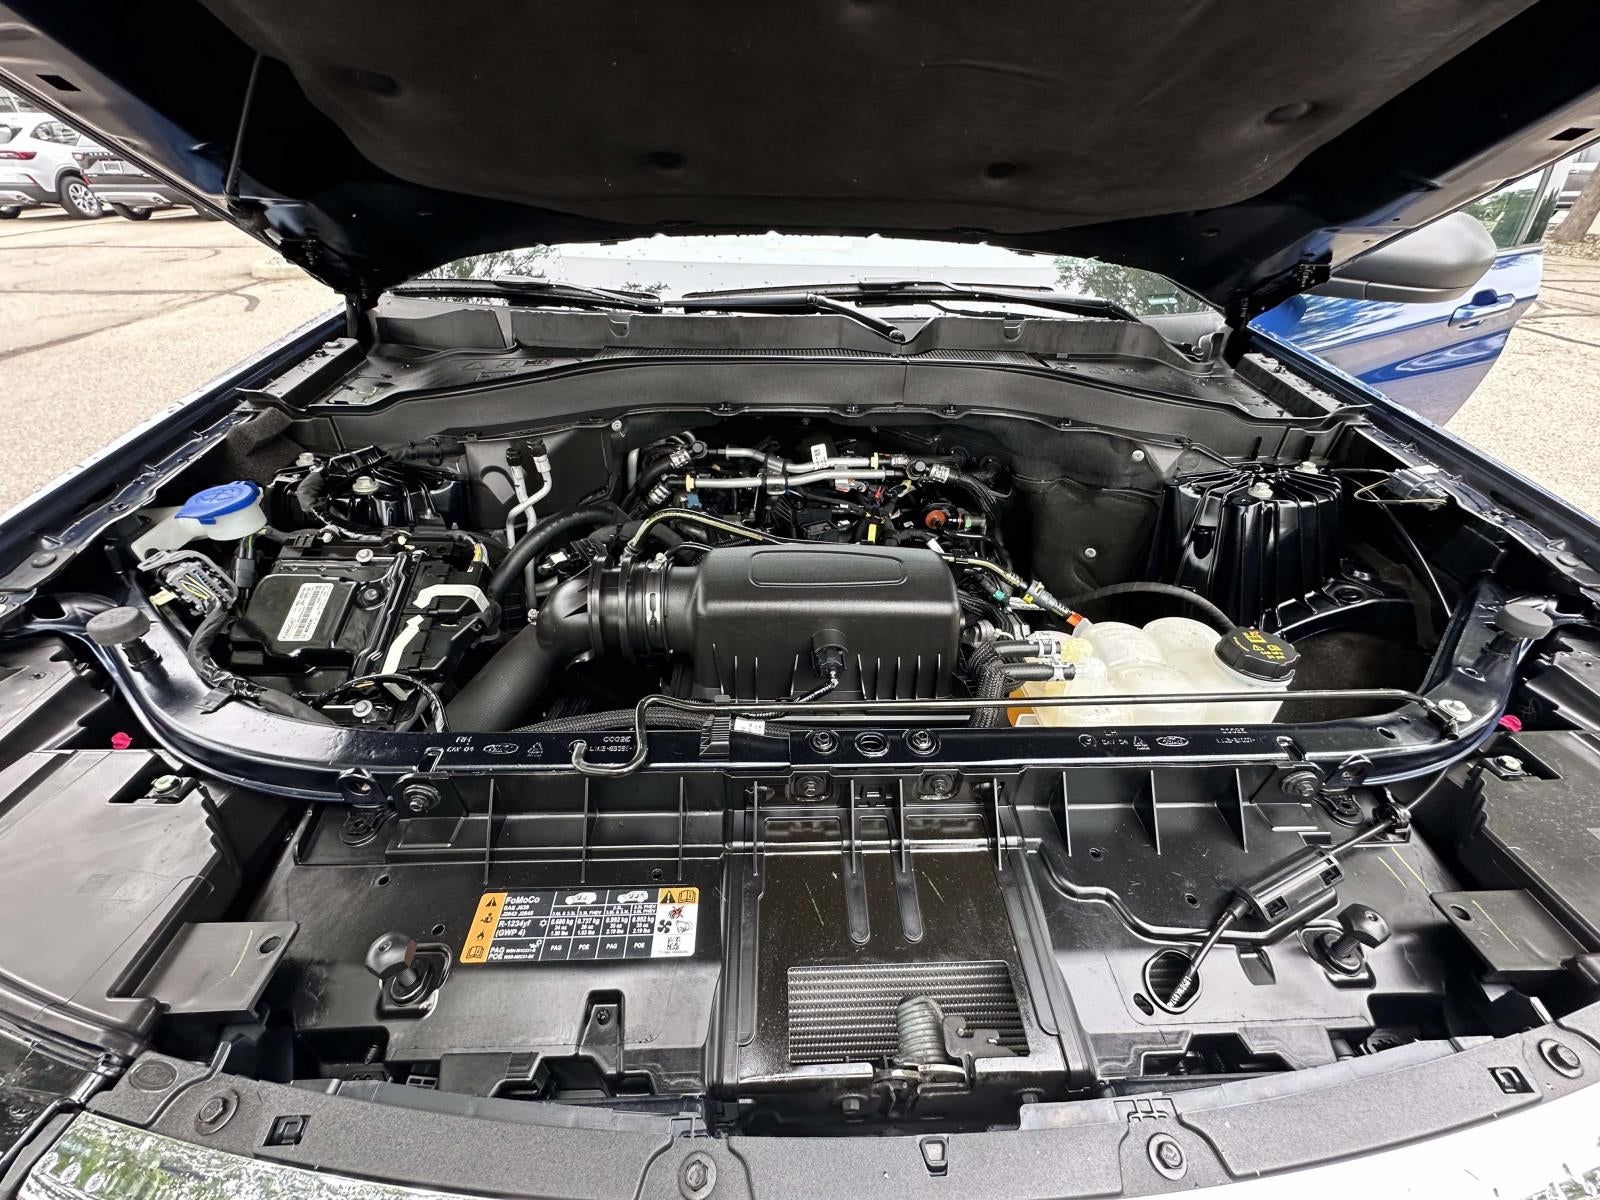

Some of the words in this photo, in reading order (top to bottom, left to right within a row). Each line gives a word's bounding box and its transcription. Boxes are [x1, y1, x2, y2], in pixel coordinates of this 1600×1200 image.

[505, 896, 540, 905] FoMoCo
[566, 918, 574, 926] kg
[592, 917, 600, 925] kg
[621, 916, 628, 924] kg
[647, 915, 655, 923] kg
[498, 919, 532, 928] R-1234yf
[495, 928, 517, 938] (GWP
[517, 928, 526, 937] 4)
